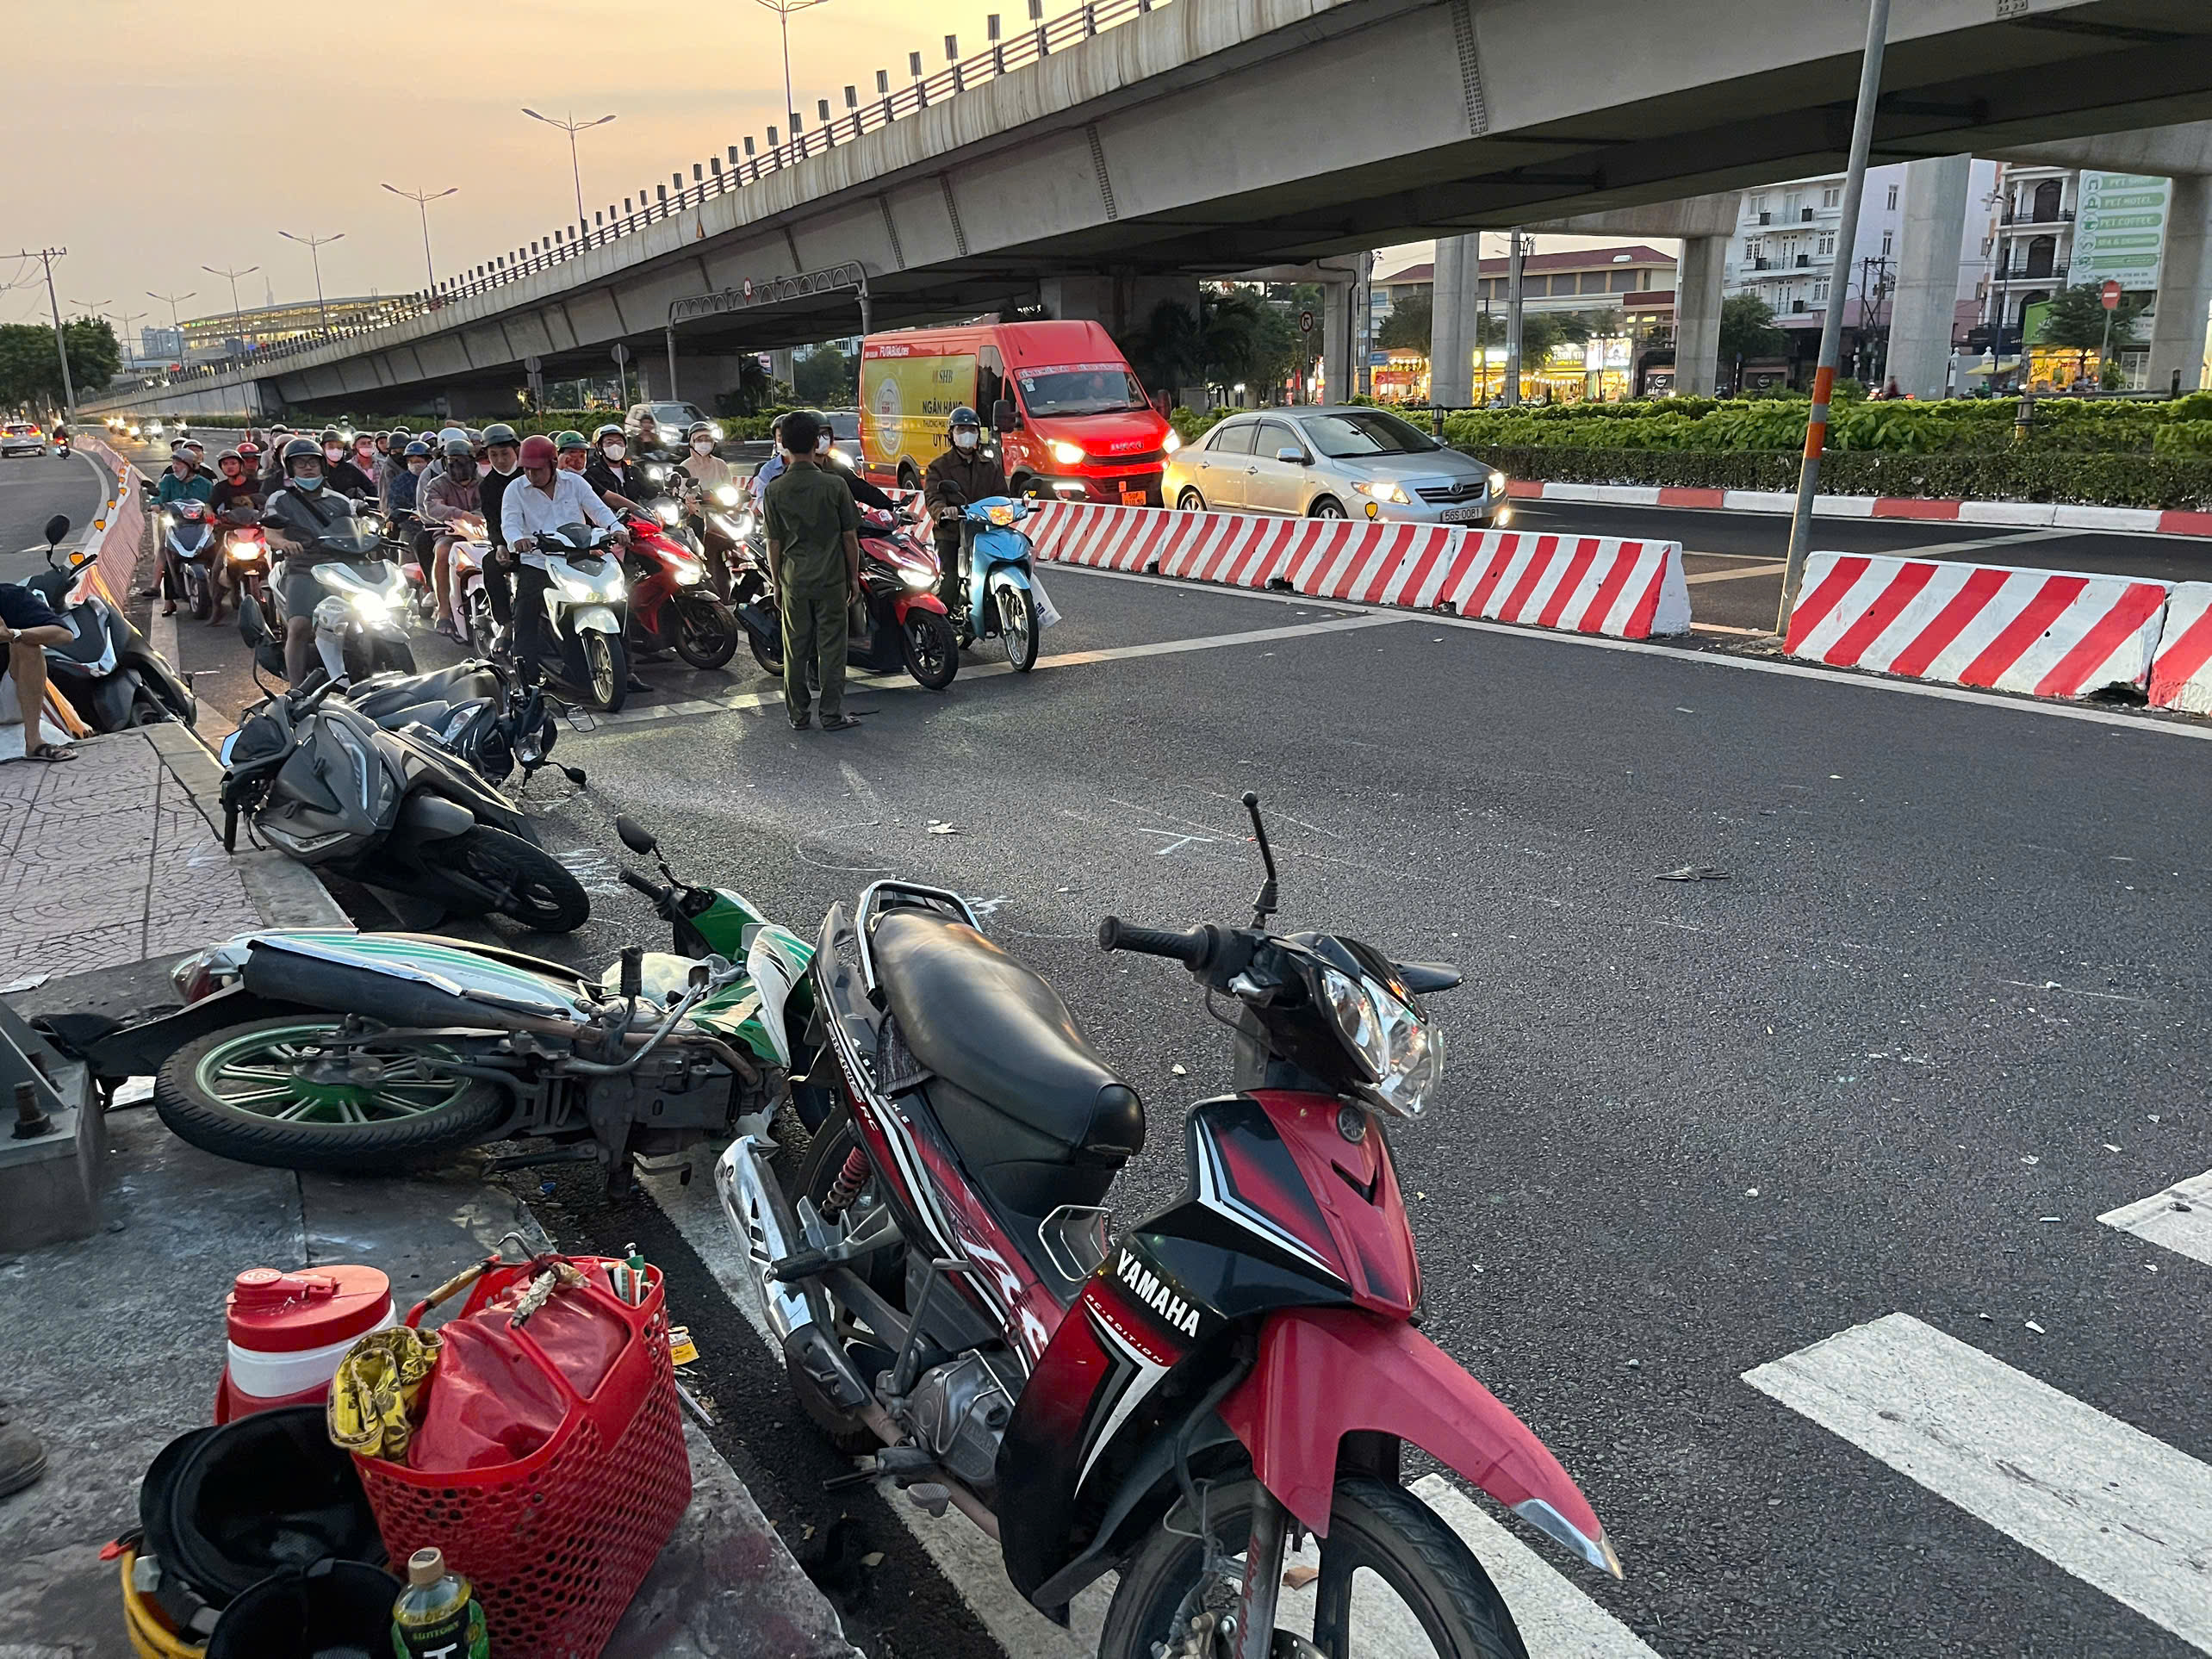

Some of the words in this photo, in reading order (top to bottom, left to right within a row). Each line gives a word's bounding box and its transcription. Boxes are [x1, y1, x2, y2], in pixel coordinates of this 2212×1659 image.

[940, 370, 953, 383] SHB
[923, 398, 941, 414] NGÂN
[1110, 441, 1144, 451] IVECO
[860, 1105, 879, 1132] RC
[1116, 1247, 1201, 1339] YAMAHA
